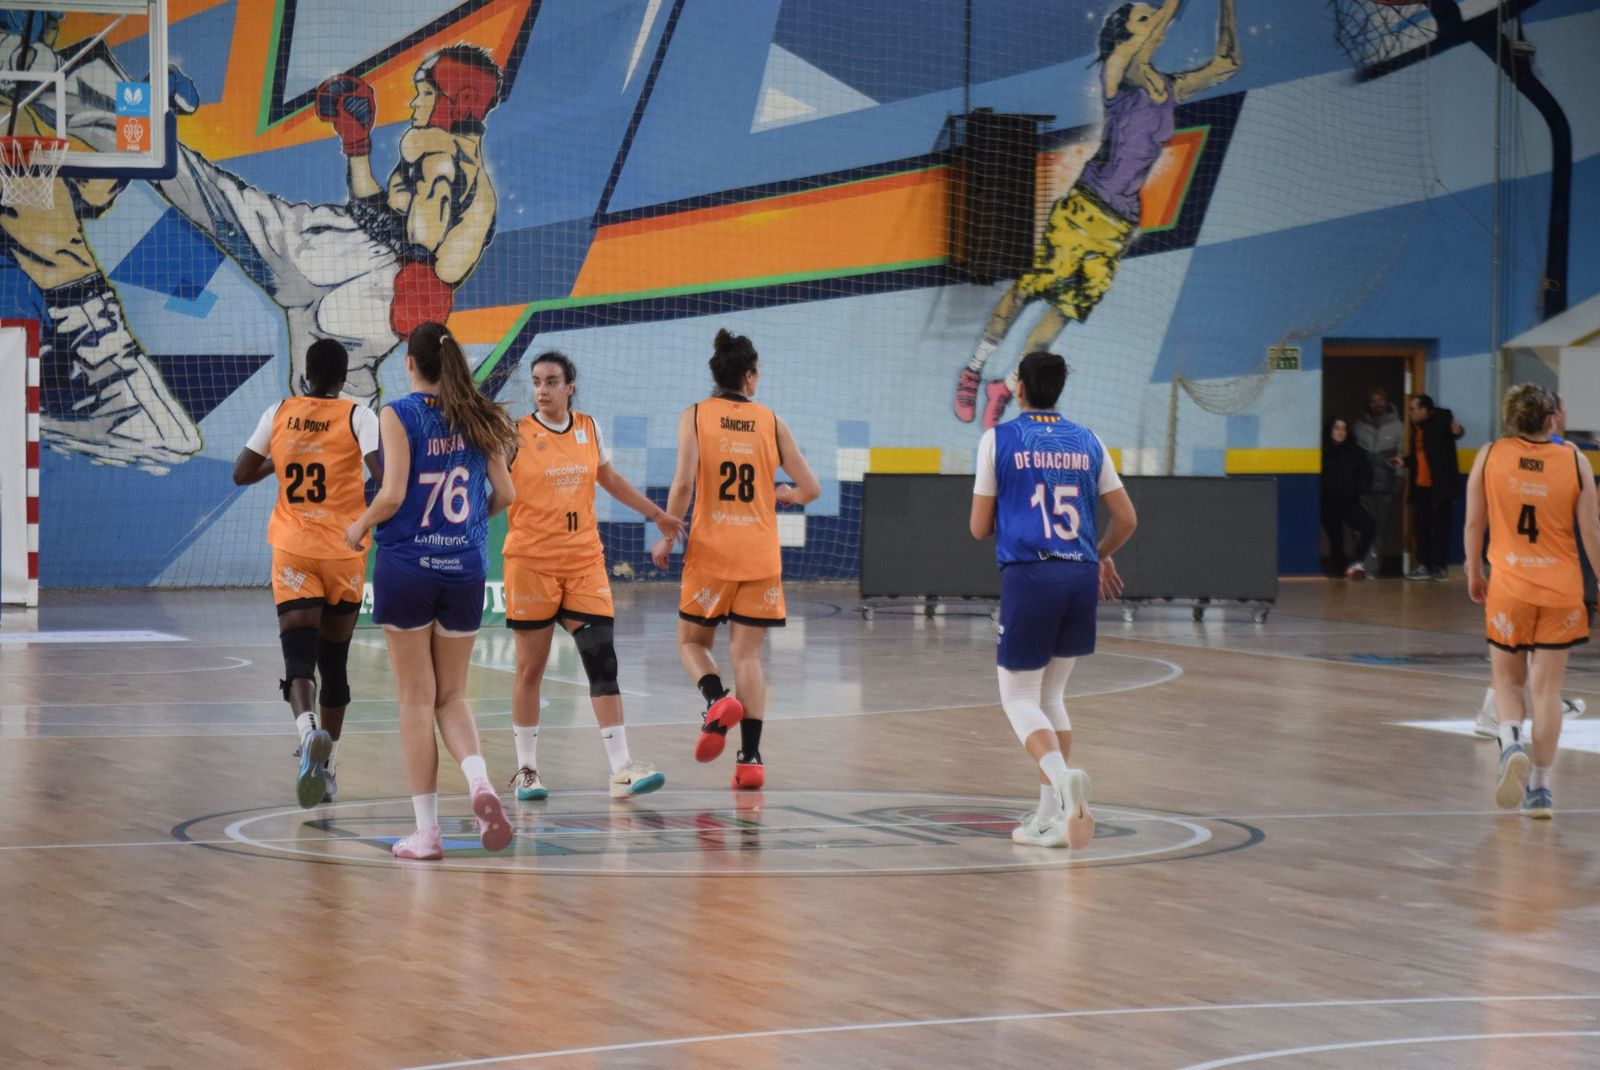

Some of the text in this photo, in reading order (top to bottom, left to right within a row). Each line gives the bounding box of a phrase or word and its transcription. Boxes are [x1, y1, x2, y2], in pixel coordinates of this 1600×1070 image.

[720, 416, 756, 433] SÁNCHEZ
[545, 463, 589, 477] recoletos
[1014, 451, 1090, 471] DE GIACOMO
[285, 462, 327, 504] 23
[418, 466, 470, 528] 76
[719, 461, 755, 503] 28
[566, 511, 578, 532] 11
[1030, 484, 1080, 541] 15
[1517, 504, 1539, 544] 4
